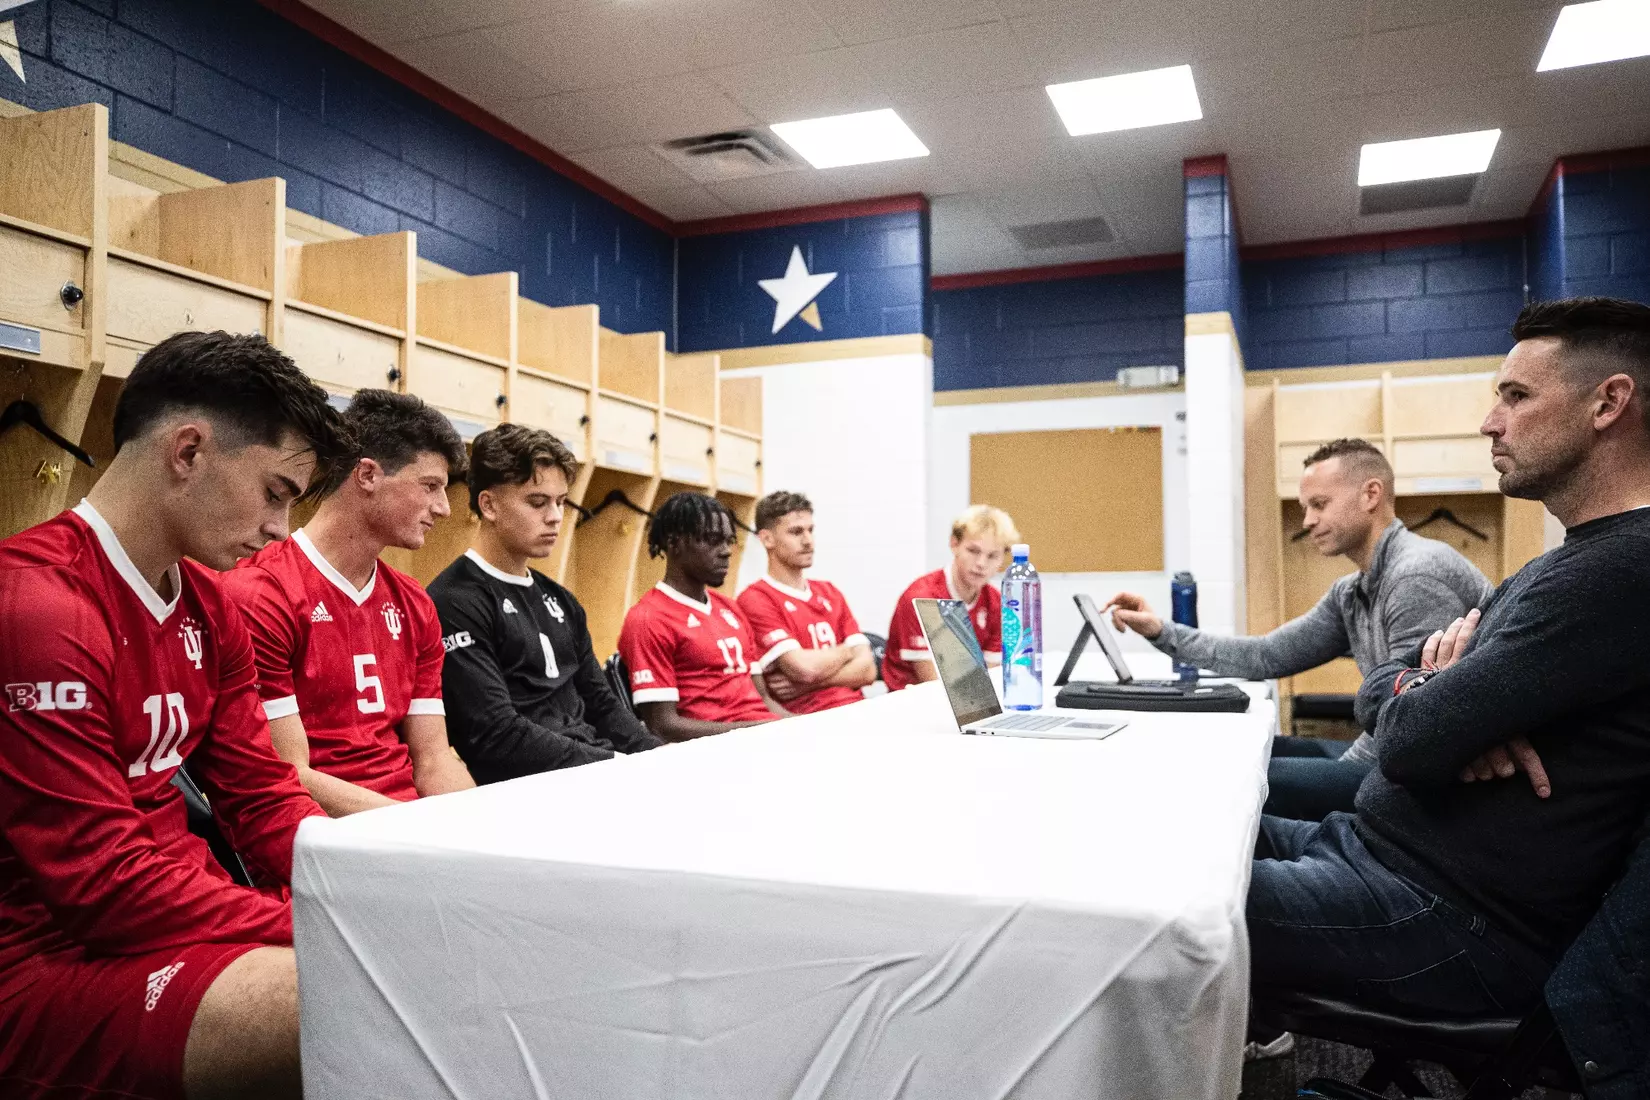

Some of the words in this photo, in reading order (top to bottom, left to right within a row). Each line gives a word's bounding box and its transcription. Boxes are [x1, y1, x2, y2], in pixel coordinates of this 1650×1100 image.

[539, 632, 559, 678] 1
[716, 636, 747, 674] 17
[807, 621, 837, 649] 19
[353, 653, 385, 714] 5
[128, 692, 189, 778] 10
[145, 961, 185, 1012] adidas
